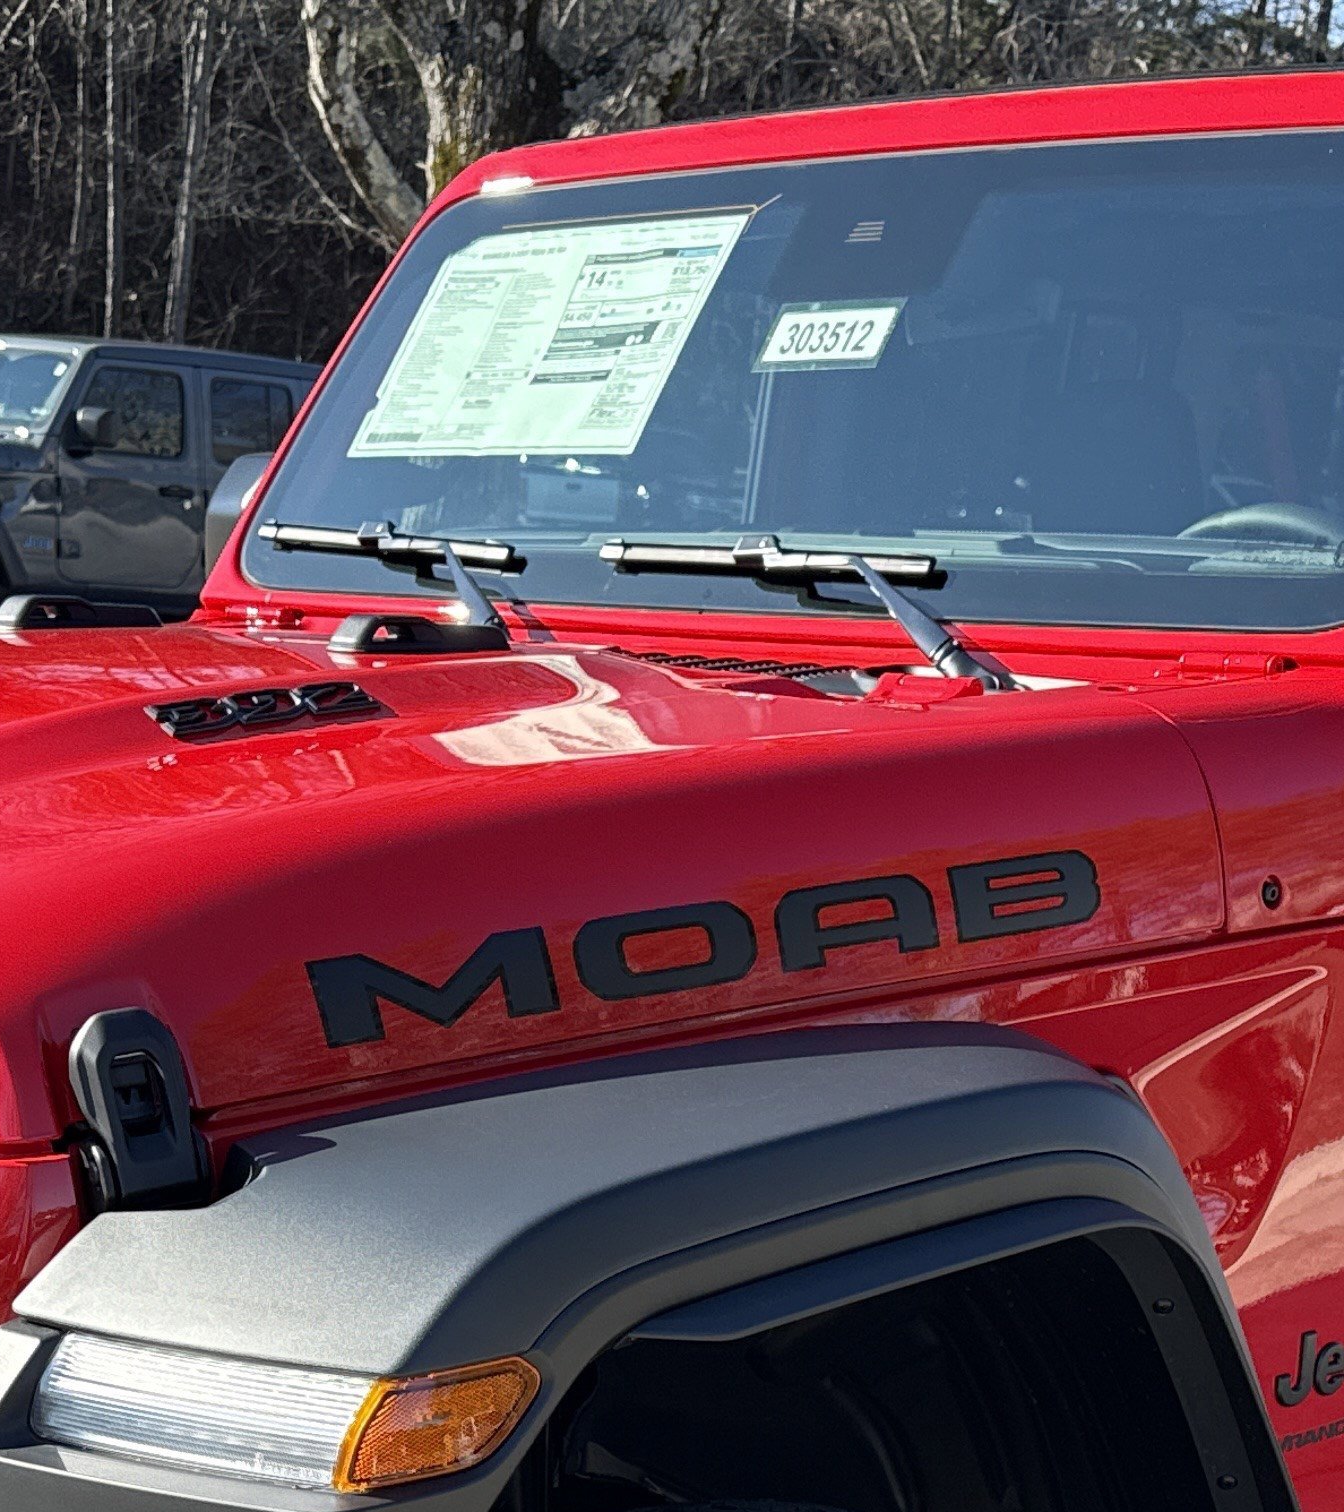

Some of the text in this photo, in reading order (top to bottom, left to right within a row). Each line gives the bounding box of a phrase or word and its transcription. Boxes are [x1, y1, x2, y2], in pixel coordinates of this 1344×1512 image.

[588, 270, 607, 288] 14
[779, 320, 875, 354] 303512
[305, 849, 1100, 1050] MOAB
